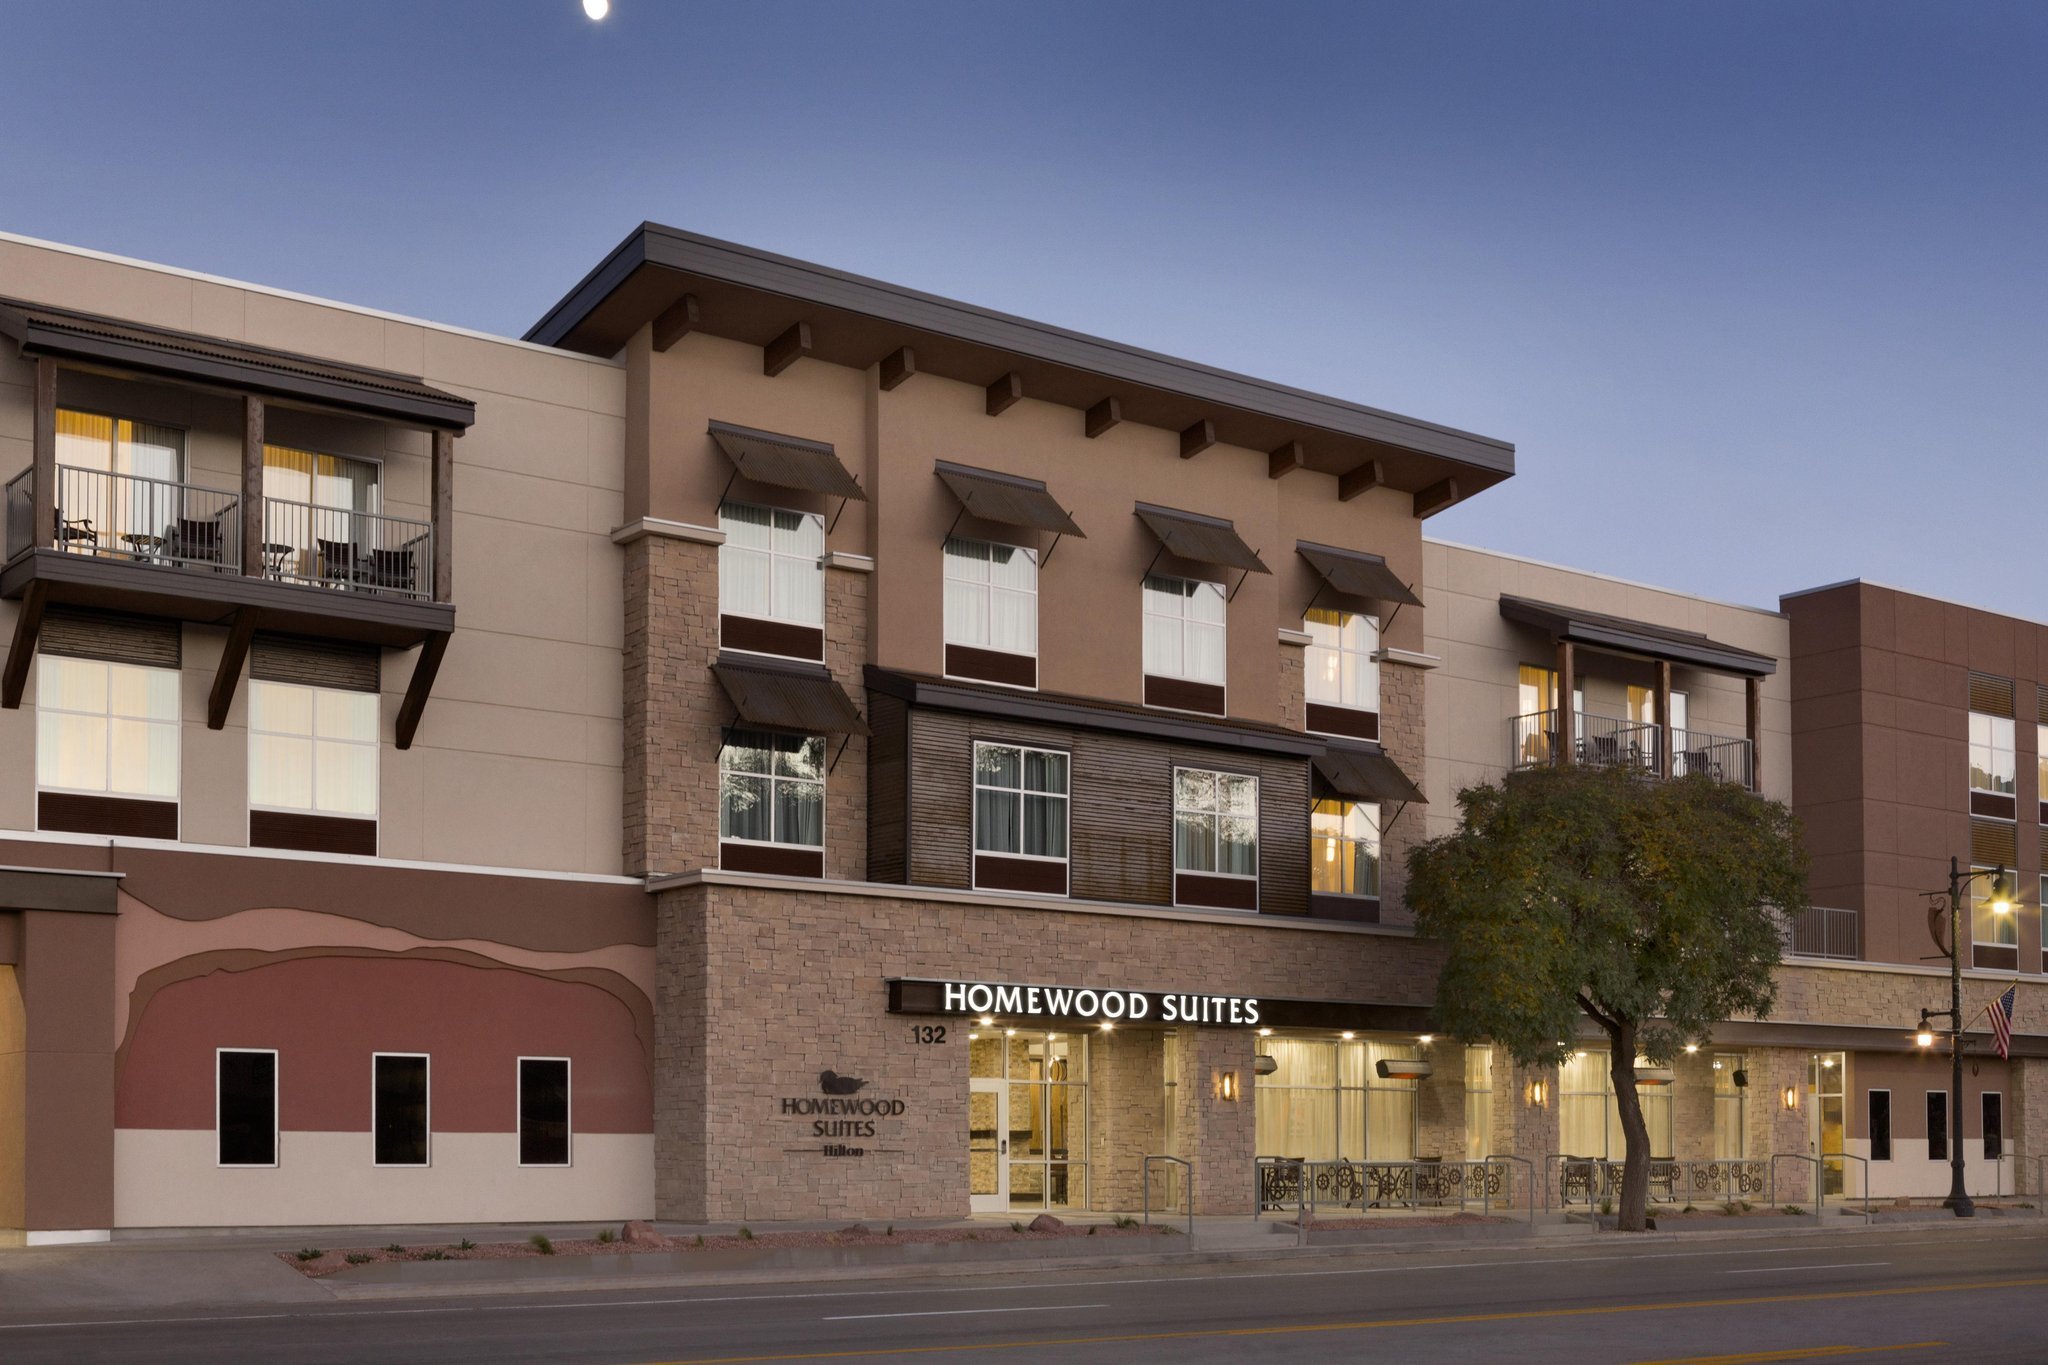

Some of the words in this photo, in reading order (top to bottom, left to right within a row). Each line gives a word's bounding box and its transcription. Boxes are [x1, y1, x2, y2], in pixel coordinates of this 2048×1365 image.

[944, 982, 1149, 1019] HOMEWOOD
[1162, 994, 1259, 1025] SUITES
[911, 1025, 946, 1044] 132
[782, 1098, 905, 1116] HOMEWOOD
[813, 1119, 875, 1137] SUITES
